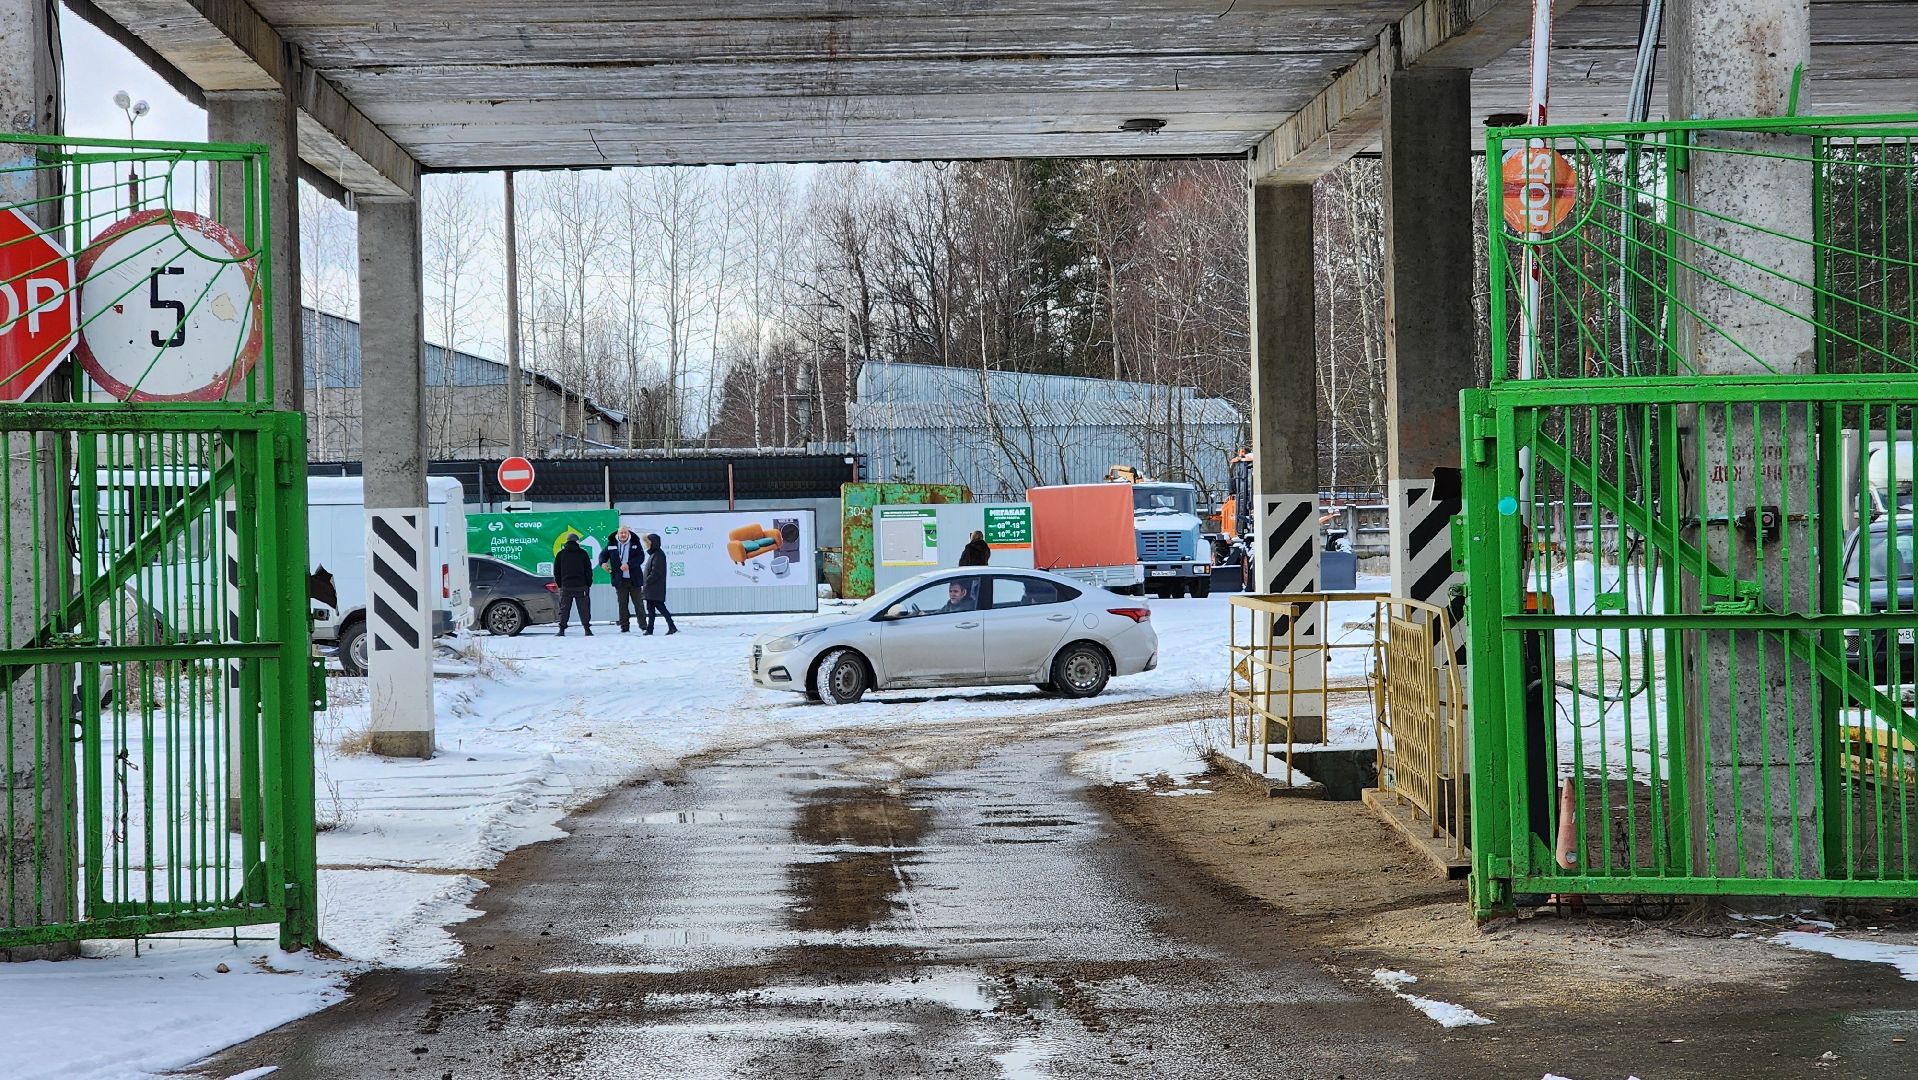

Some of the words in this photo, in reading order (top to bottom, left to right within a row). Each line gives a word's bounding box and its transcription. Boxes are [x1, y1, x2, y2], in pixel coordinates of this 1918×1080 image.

[1520, 153, 1552, 227] STOP
[151, 266, 186, 348] 5
[847, 506, 867, 517] 304
[490, 536, 507, 546] Дай
[490, 545, 523, 553] вторую
